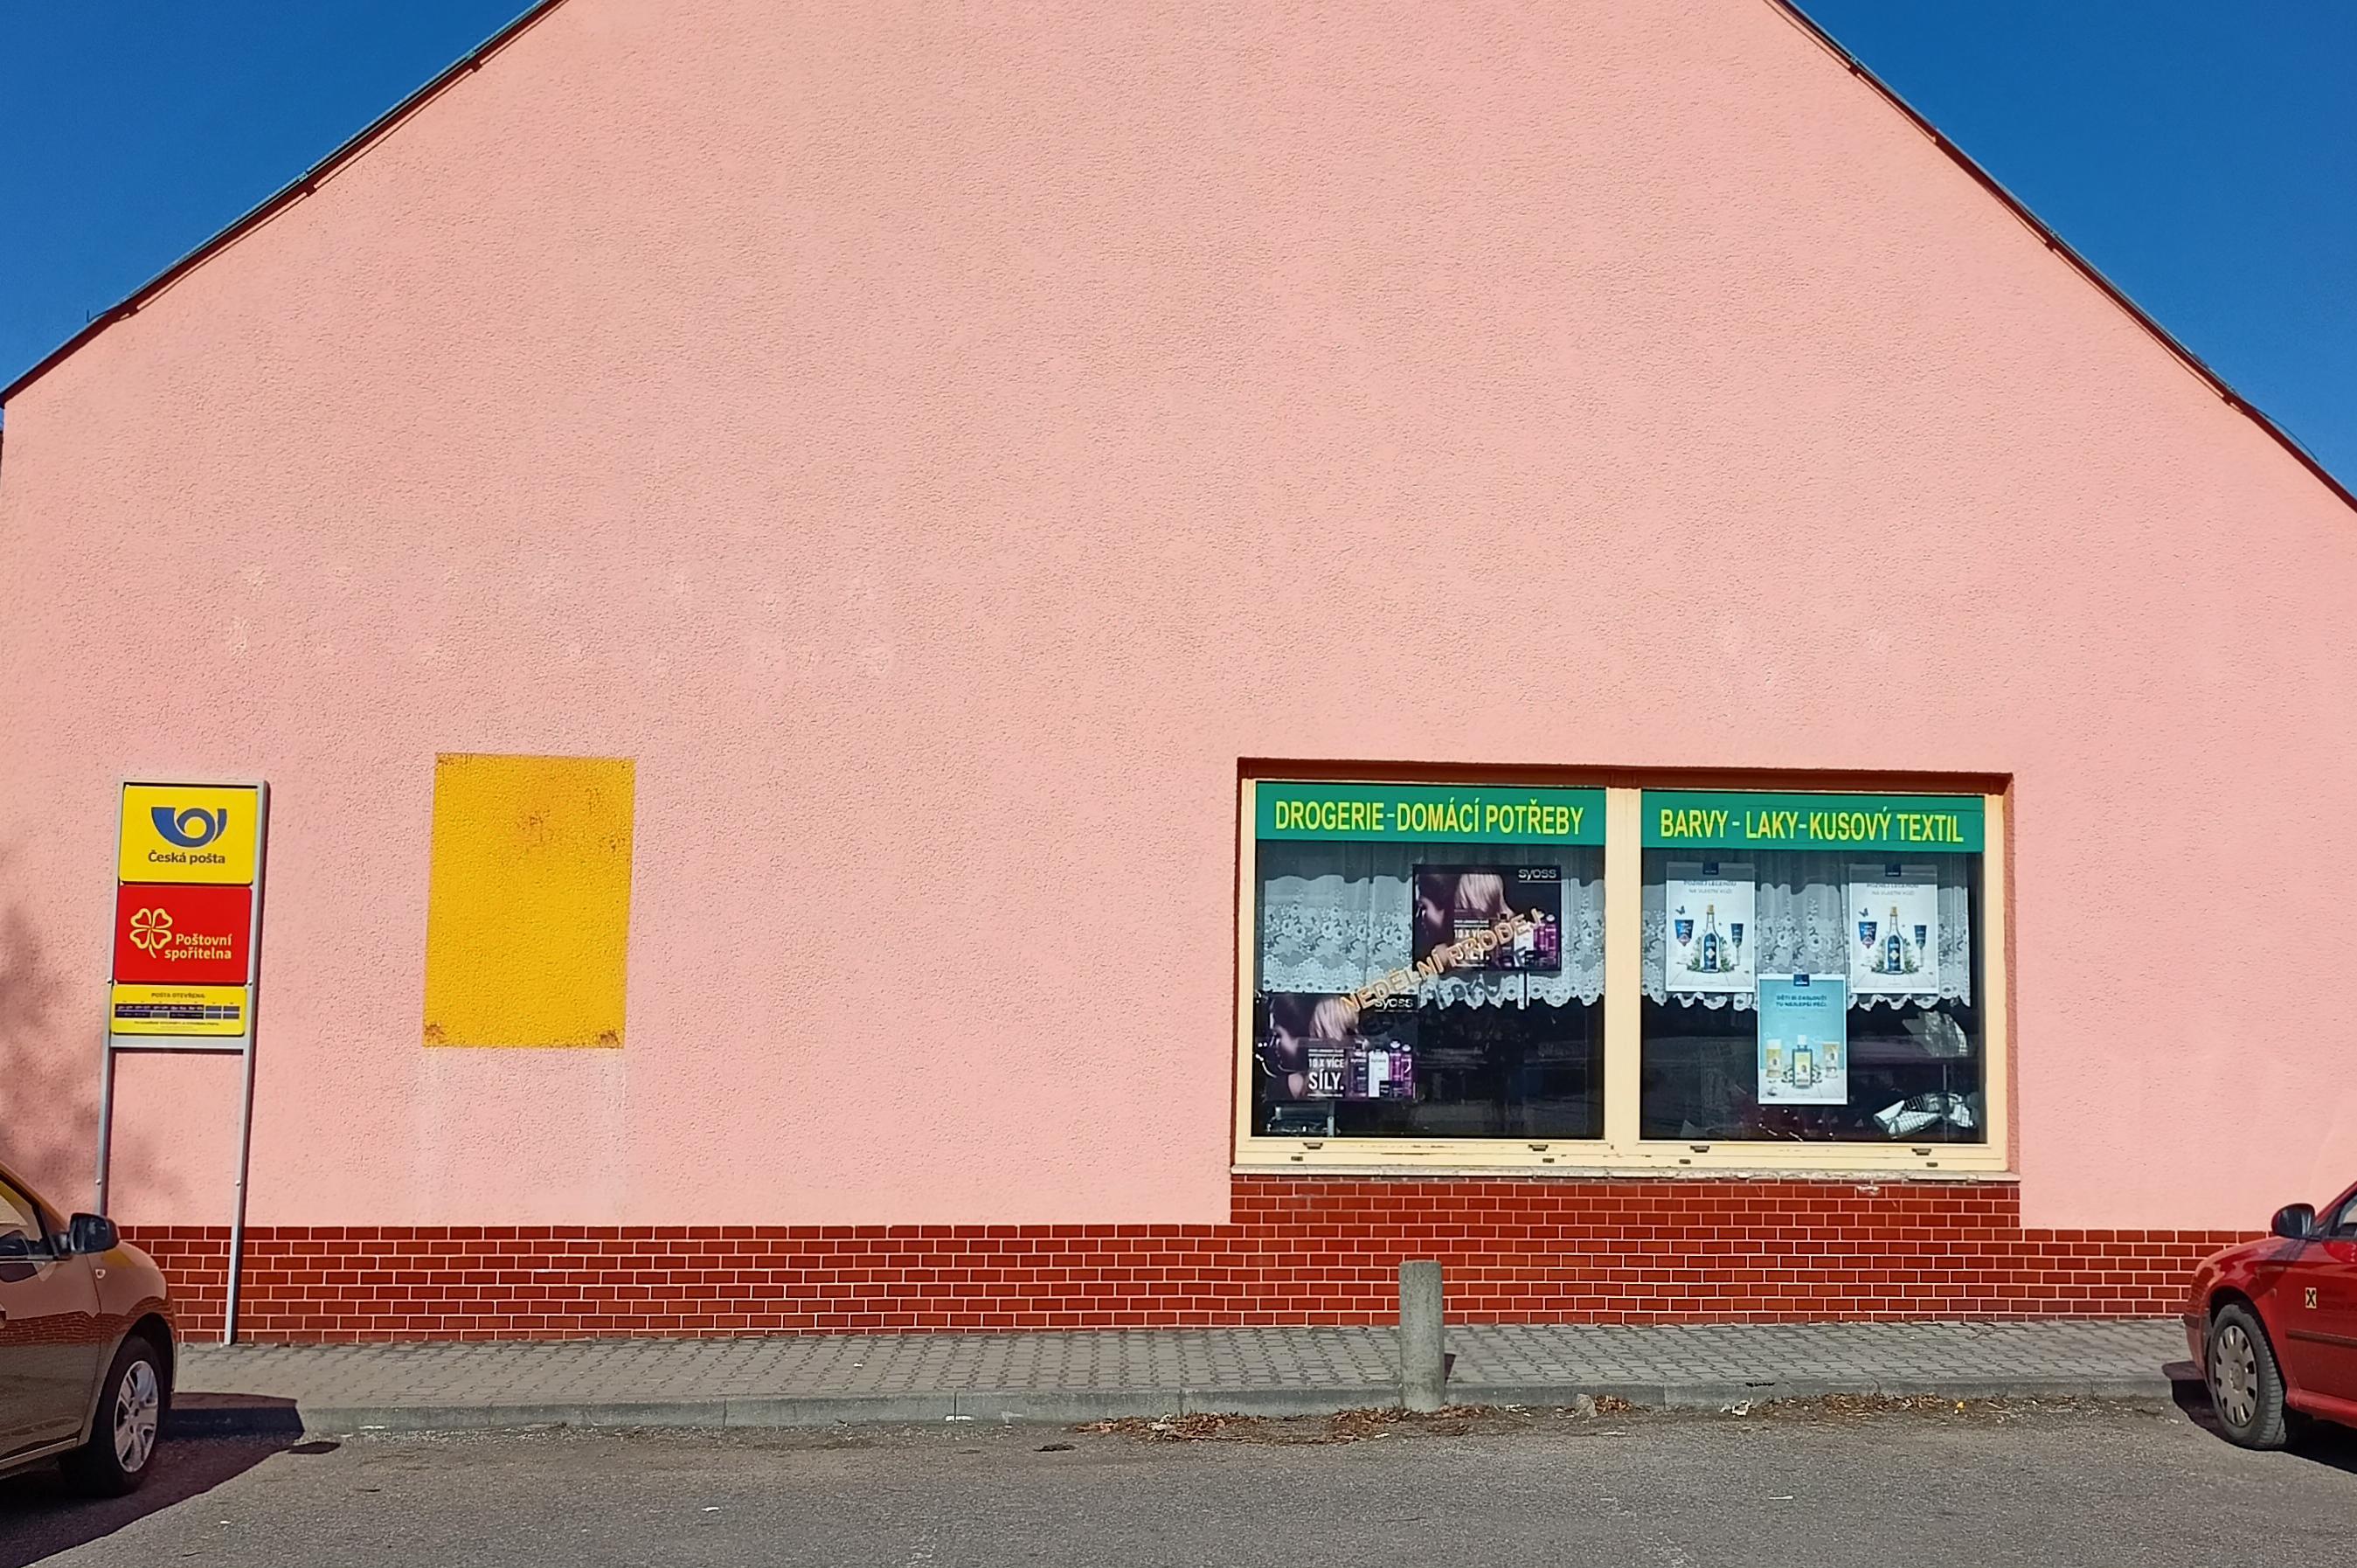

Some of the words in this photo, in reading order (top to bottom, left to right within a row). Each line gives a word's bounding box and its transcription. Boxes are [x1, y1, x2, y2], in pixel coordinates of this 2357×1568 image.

[1486, 799, 1584, 834] POTŘEBY
[1660, 808, 1729, 838] BARVY
[1896, 814, 1965, 843] TEXTIL
[148, 850, 186, 864] Česká
[189, 853, 225, 865] pošta
[176, 933, 232, 946] Poštovní
[164, 947, 232, 961] spořitelna
[1340, 948, 1445, 1012] NEDĚLNÍ
[1445, 907, 1546, 968] PRODEJ
[1308, 1058, 1318, 1068] 10
[1319, 1058, 1324, 1068] X
[1326, 1056, 1345, 1068] VÍCE
[1308, 1068, 1345, 1091] SÍLY.
